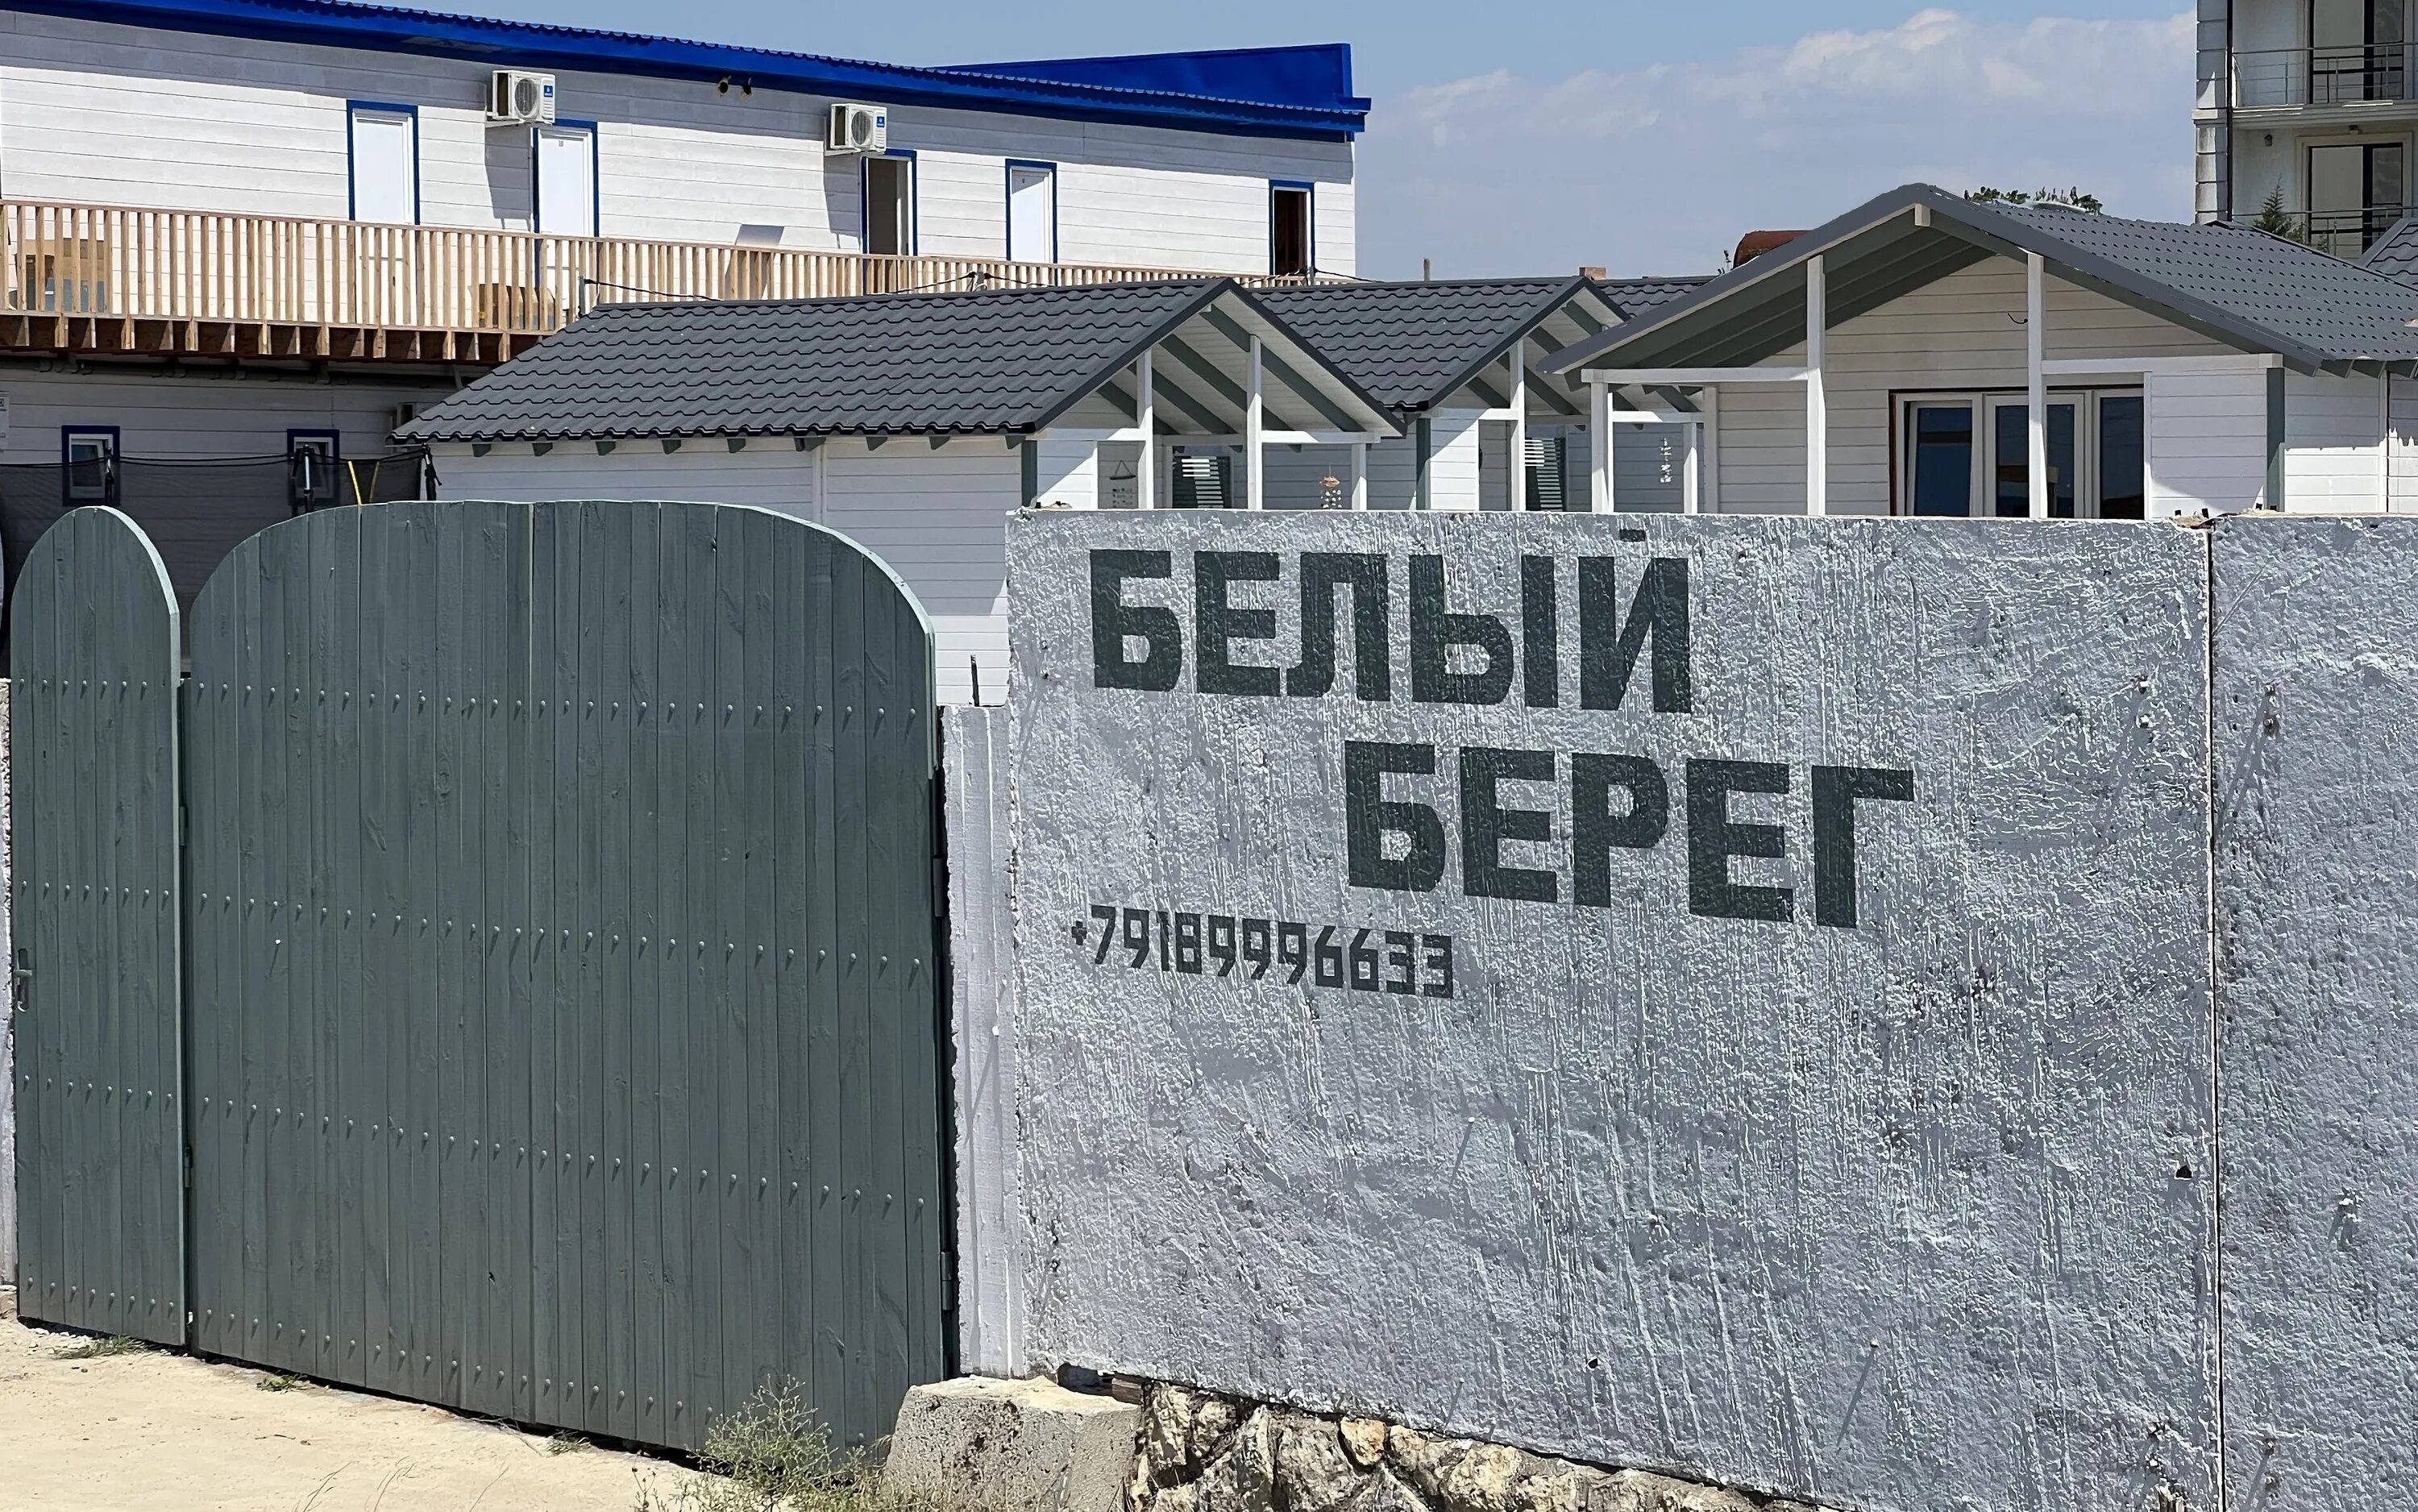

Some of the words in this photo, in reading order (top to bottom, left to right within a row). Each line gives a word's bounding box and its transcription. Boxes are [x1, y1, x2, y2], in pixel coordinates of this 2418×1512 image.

[1091, 529, 1692, 713] БЕЛЫЙ
[1344, 740, 1913, 928] БЕРЕГ
[1072, 904, 1453, 999] +79189996633
